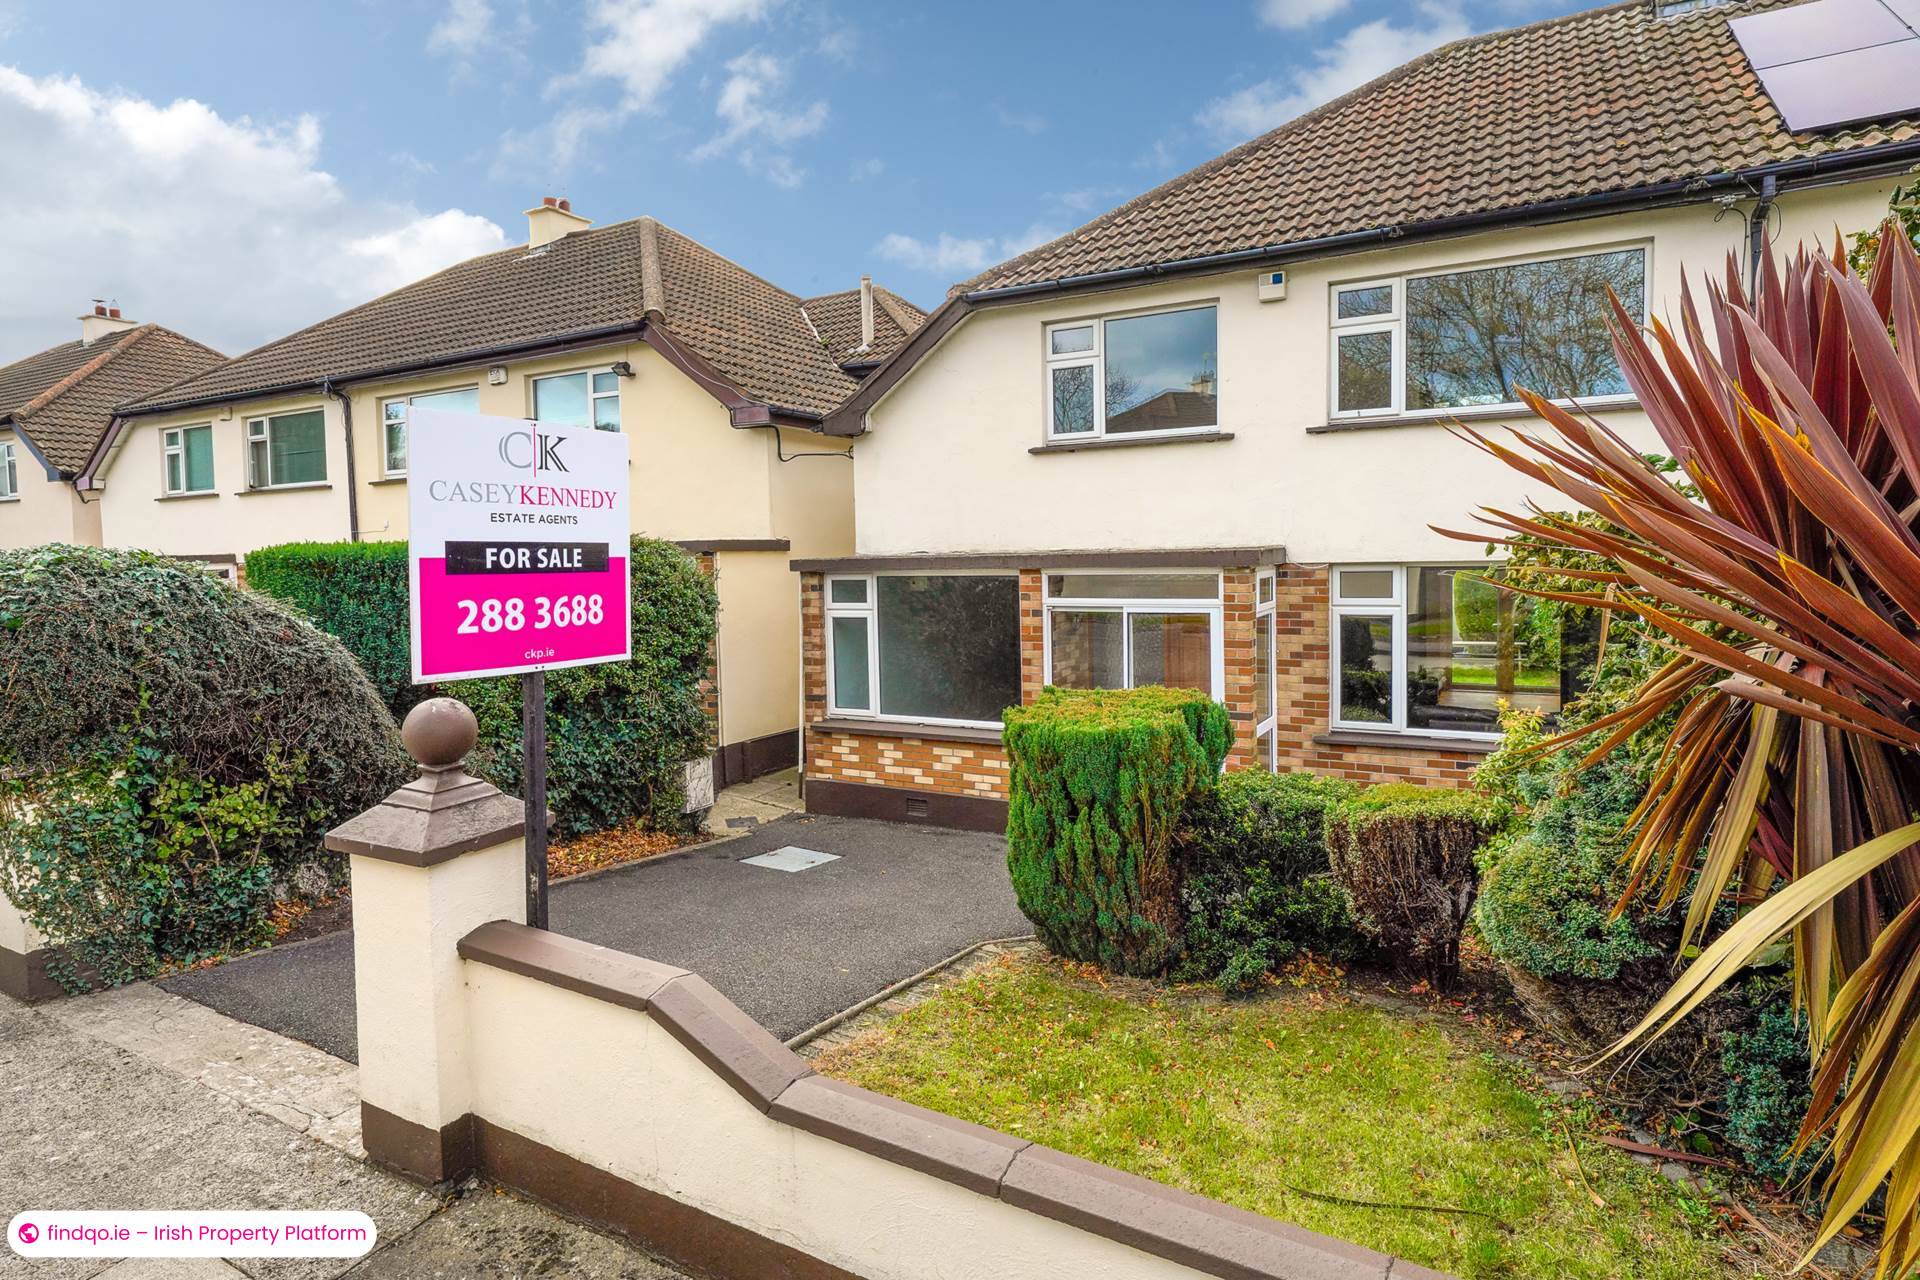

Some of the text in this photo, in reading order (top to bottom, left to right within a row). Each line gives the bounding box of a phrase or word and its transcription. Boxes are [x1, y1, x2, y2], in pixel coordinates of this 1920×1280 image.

[490, 512, 578, 525] ESTATE AGENTS
[485, 547, 583, 569] FOR SALE
[457, 594, 604, 634] 288 3688
[524, 647, 555, 660] ckp.ie
